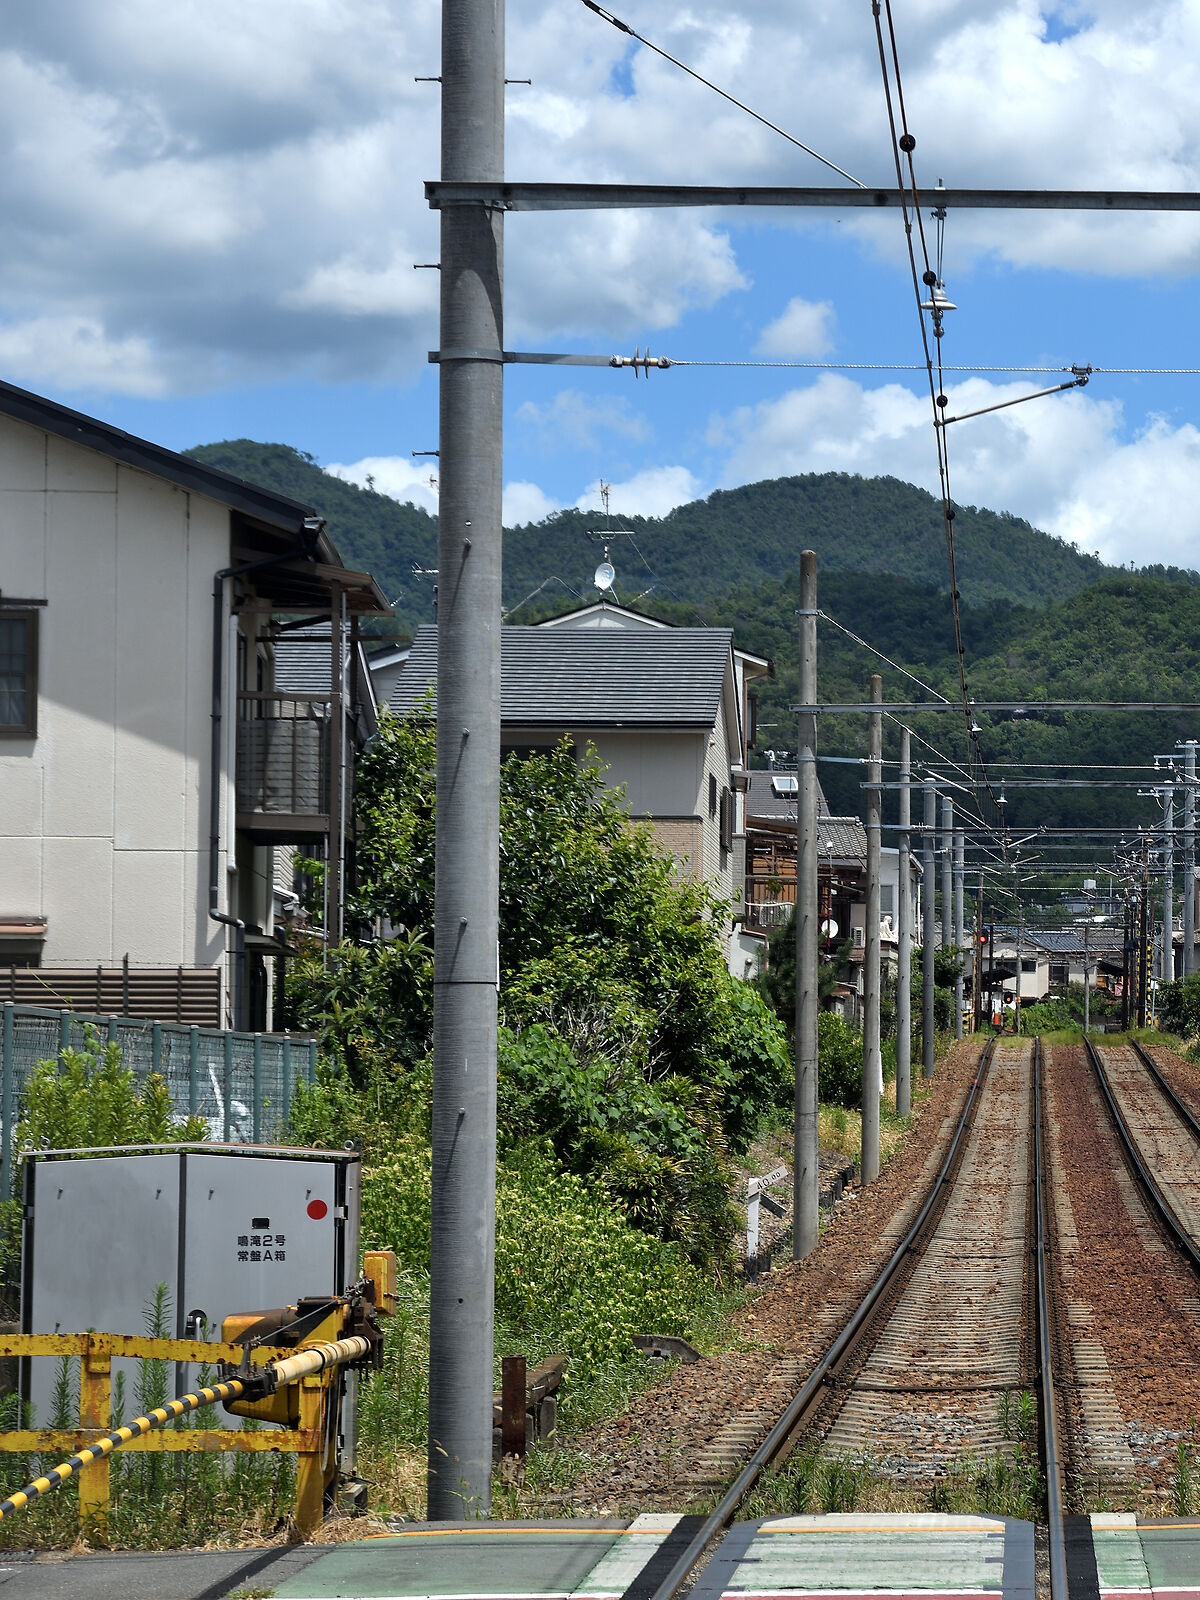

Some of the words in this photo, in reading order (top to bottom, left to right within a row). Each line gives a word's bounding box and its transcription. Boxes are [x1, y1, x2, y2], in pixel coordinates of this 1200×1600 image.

[237, 1234, 286, 1247] 鳴滝2号
[237, 1250, 286, 1262] 常盤A箱
